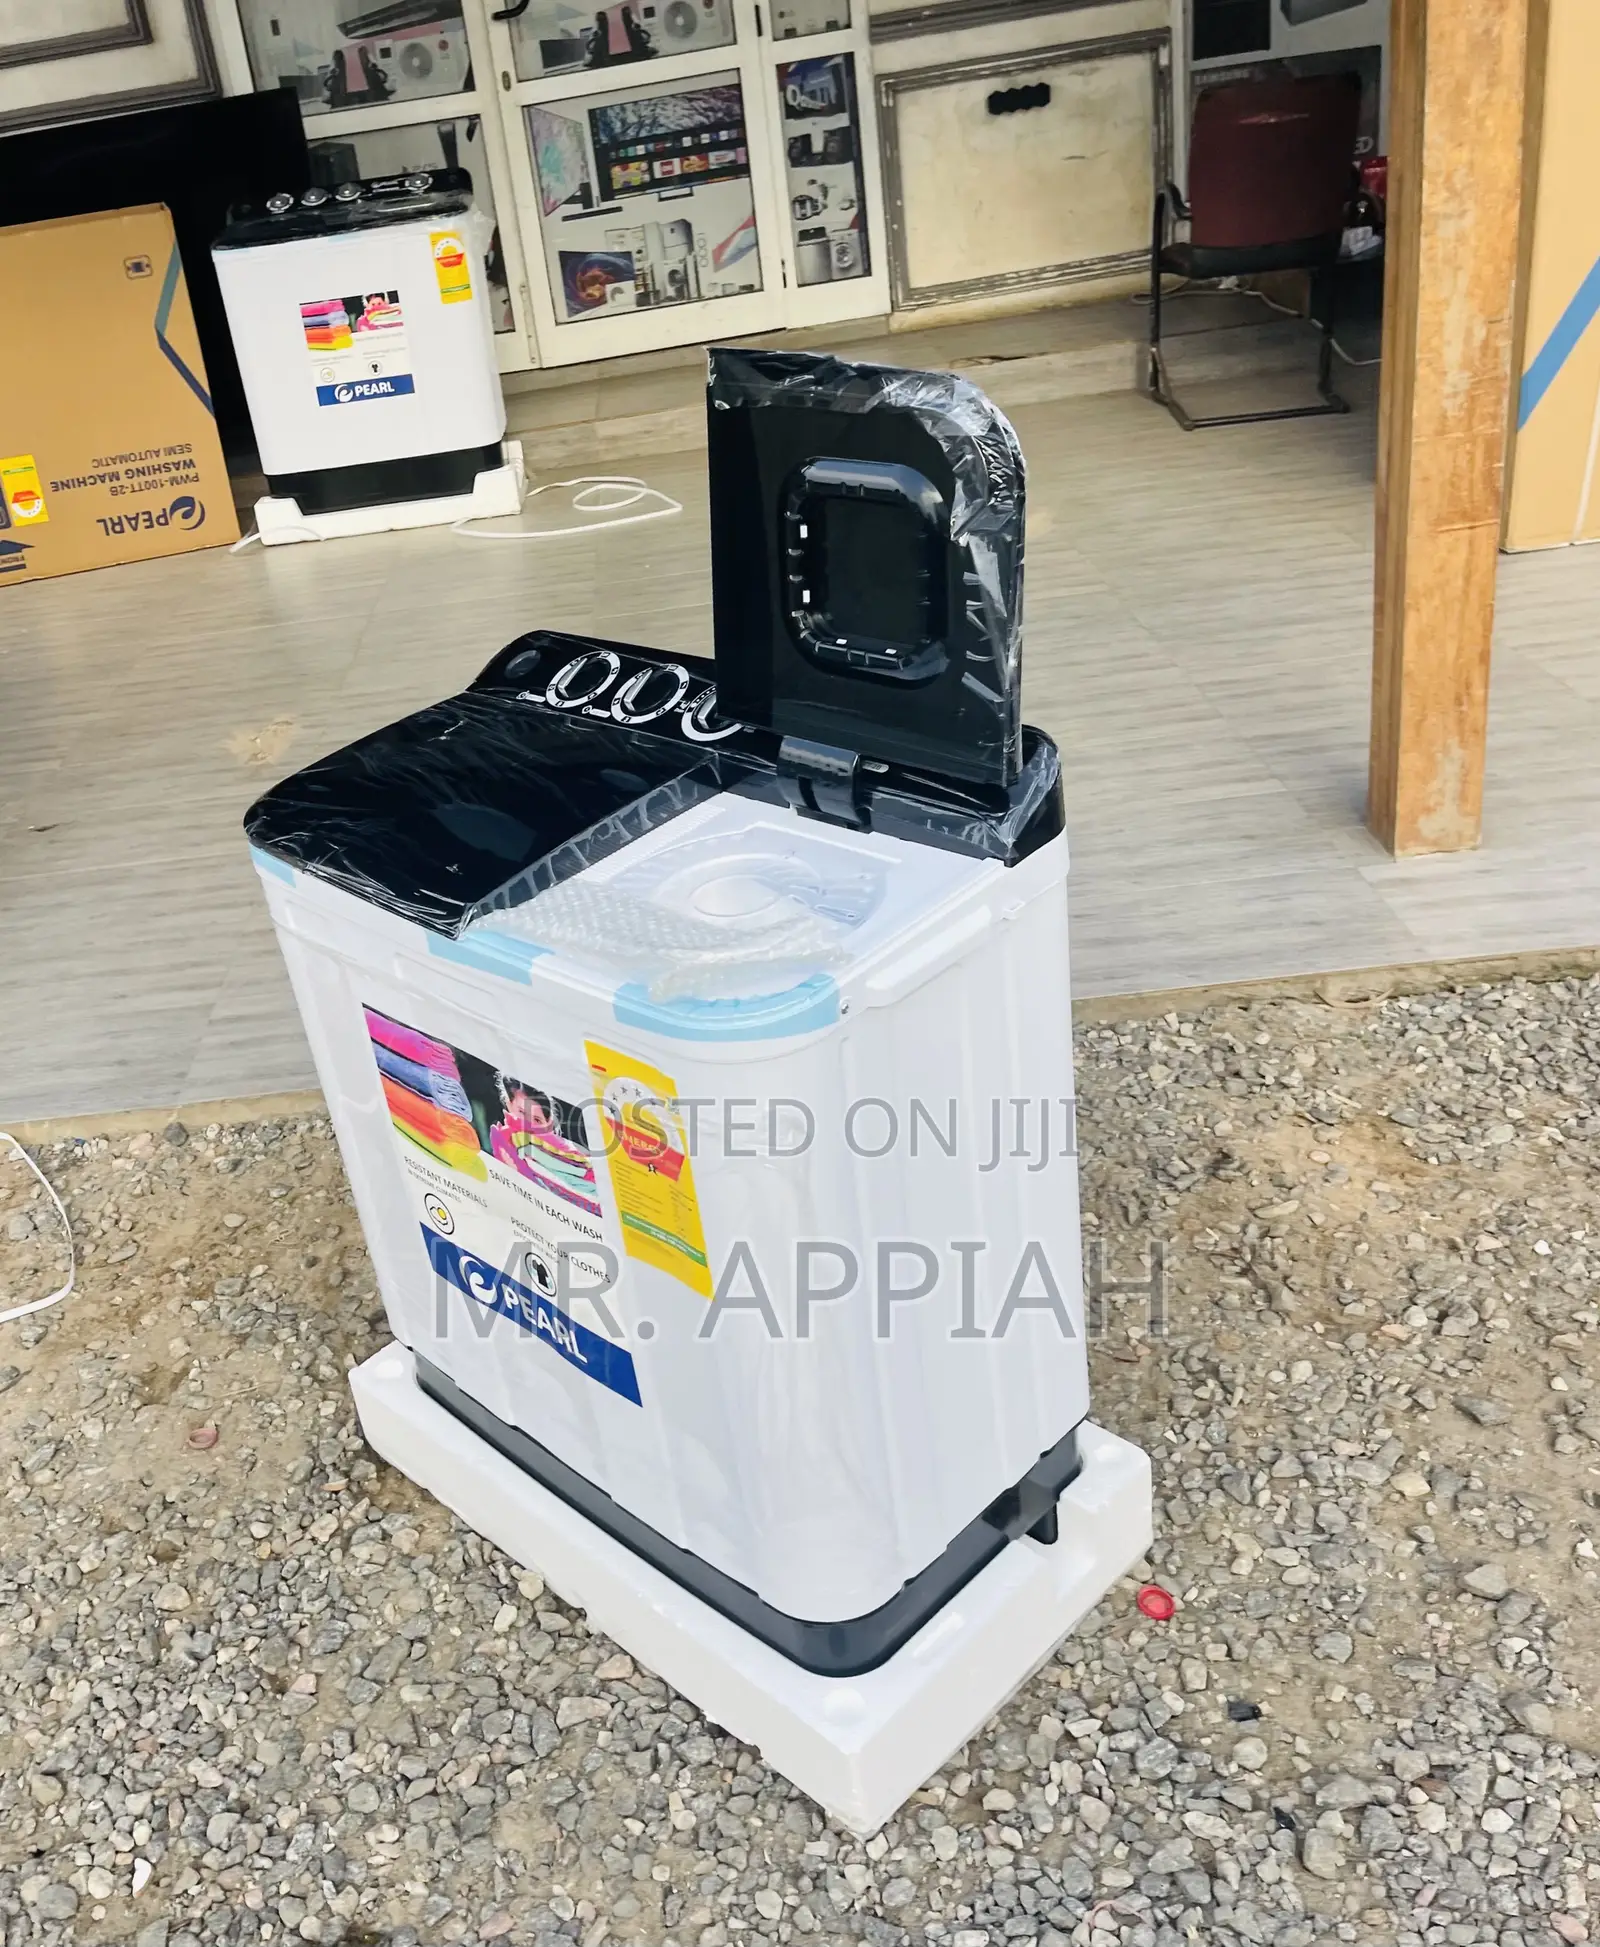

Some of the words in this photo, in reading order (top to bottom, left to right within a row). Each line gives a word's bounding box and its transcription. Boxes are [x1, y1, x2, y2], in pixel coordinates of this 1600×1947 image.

[354, 381, 395, 397] PEARL
[91, 448, 161, 468] AUTOMATIC
[164, 443, 193, 457] SEMI
[50, 470, 121, 492] MACHINE
[124, 459, 197, 480] WASHING
[96, 508, 170, 536] PEARL
[404, 1156, 441, 1184] RESISTANT
[443, 1178, 488, 1207] MATERIALS
[489, 1169, 512, 1188] SAVE
[512, 1182, 533, 1204] TIME
[534, 1199, 544, 1212] IN
[546, 1205, 571, 1227] EACH
[572, 1219, 603, 1243] WASH
[510, 1216, 545, 1244] PROTECT
[545, 1239, 570, 1261] YOUR
[570, 1256, 611, 1284] CLOTHES
[500, 1283, 588, 1364] PEARL
